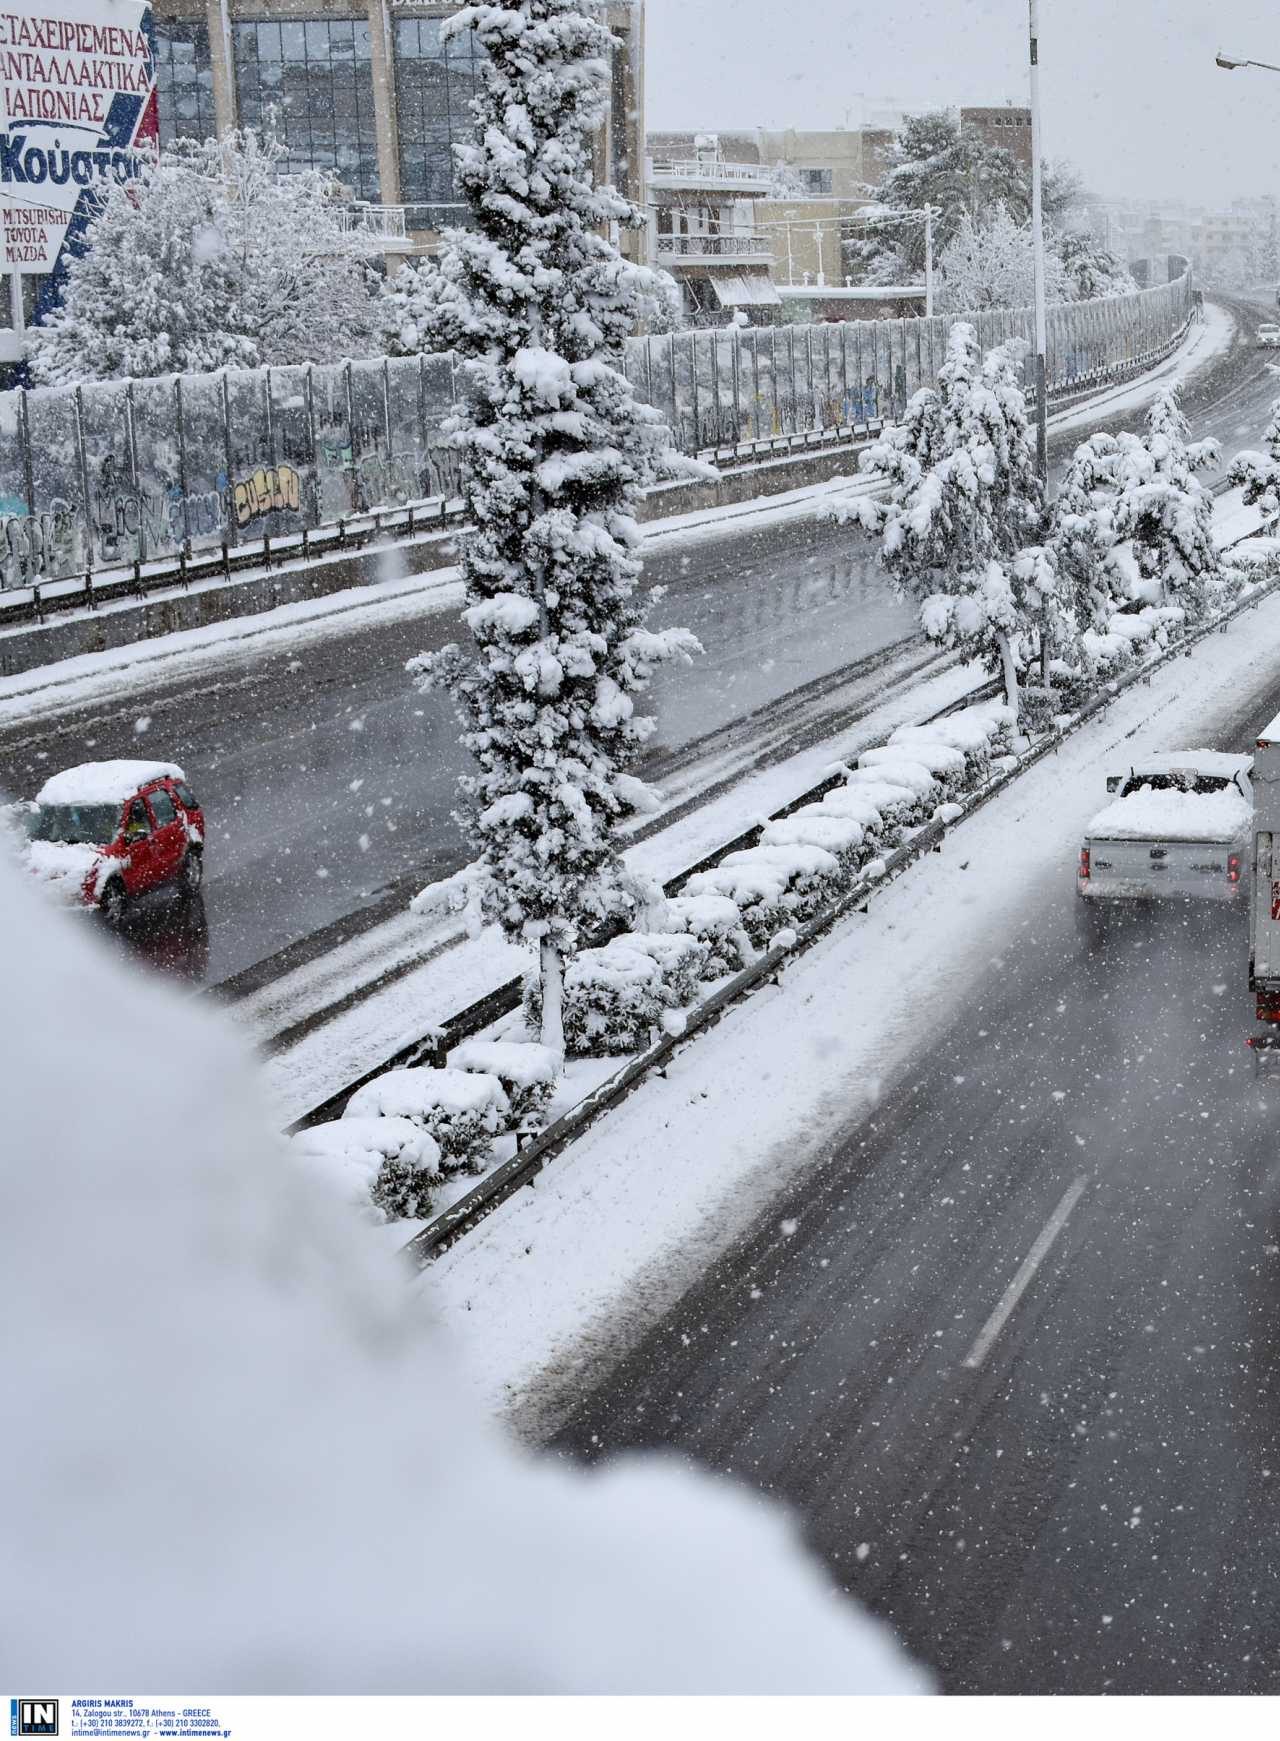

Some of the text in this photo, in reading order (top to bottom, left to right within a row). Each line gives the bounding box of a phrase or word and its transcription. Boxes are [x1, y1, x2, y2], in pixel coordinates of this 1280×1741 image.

[5, 87, 105, 122] ΙΑΠΩΝΙΑΣ
[2, 208, 68, 225] MTSUBISHI
[4, 227, 48, 243] TOYOTA
[6, 245, 48, 262] MAZDA
